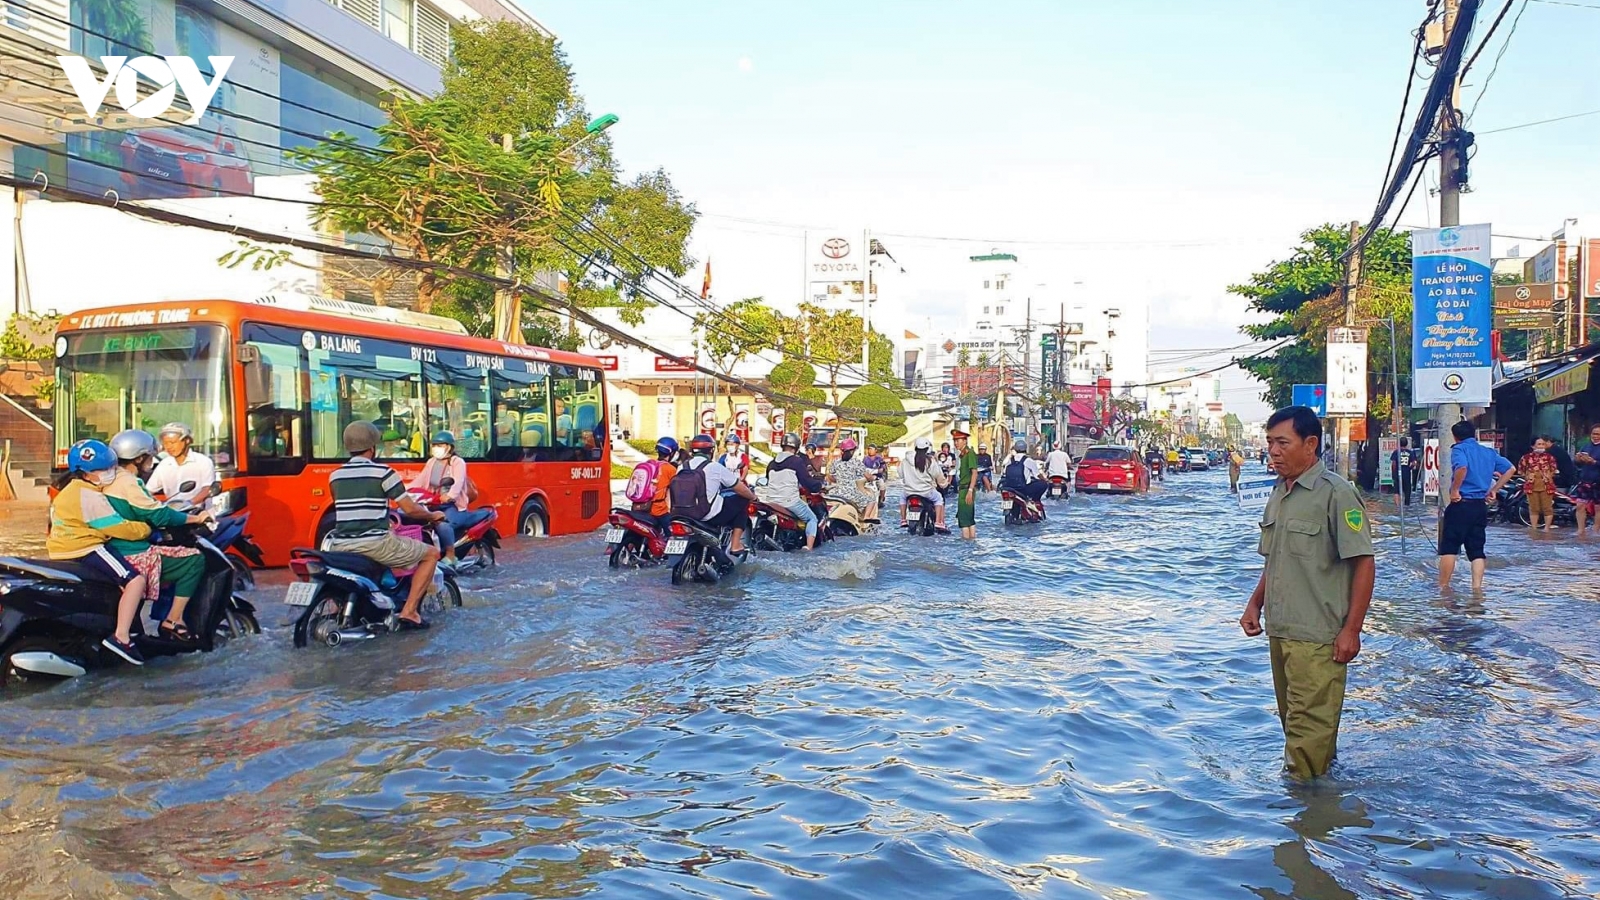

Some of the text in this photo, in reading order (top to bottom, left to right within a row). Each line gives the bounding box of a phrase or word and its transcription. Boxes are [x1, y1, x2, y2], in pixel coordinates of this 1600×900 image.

[814, 263, 859, 272] TOYOTA
[1436, 262, 1467, 275] LỄ HỘI
[1421, 274, 1484, 286] TRANG PHỤC
[1428, 286, 1477, 297] ÁO BÀ BA,
[1436, 298, 1470, 309] ÁO DÀI
[1496, 299, 1551, 308] Hai Ông Mập
[79, 316, 92, 330] XE
[157, 307, 191, 323] TRANG
[103, 332, 162, 352] XE BUÝT
[320, 335, 335, 351] BA
[335, 335, 361, 354] LÁNG
[957, 341, 980, 349] TRUNG
[411, 346, 437, 363] BV 121
[466, 354, 476, 367] BV
[583, 368, 596, 382] MÔN
[570, 466, 602, 480] 50F-001.77
